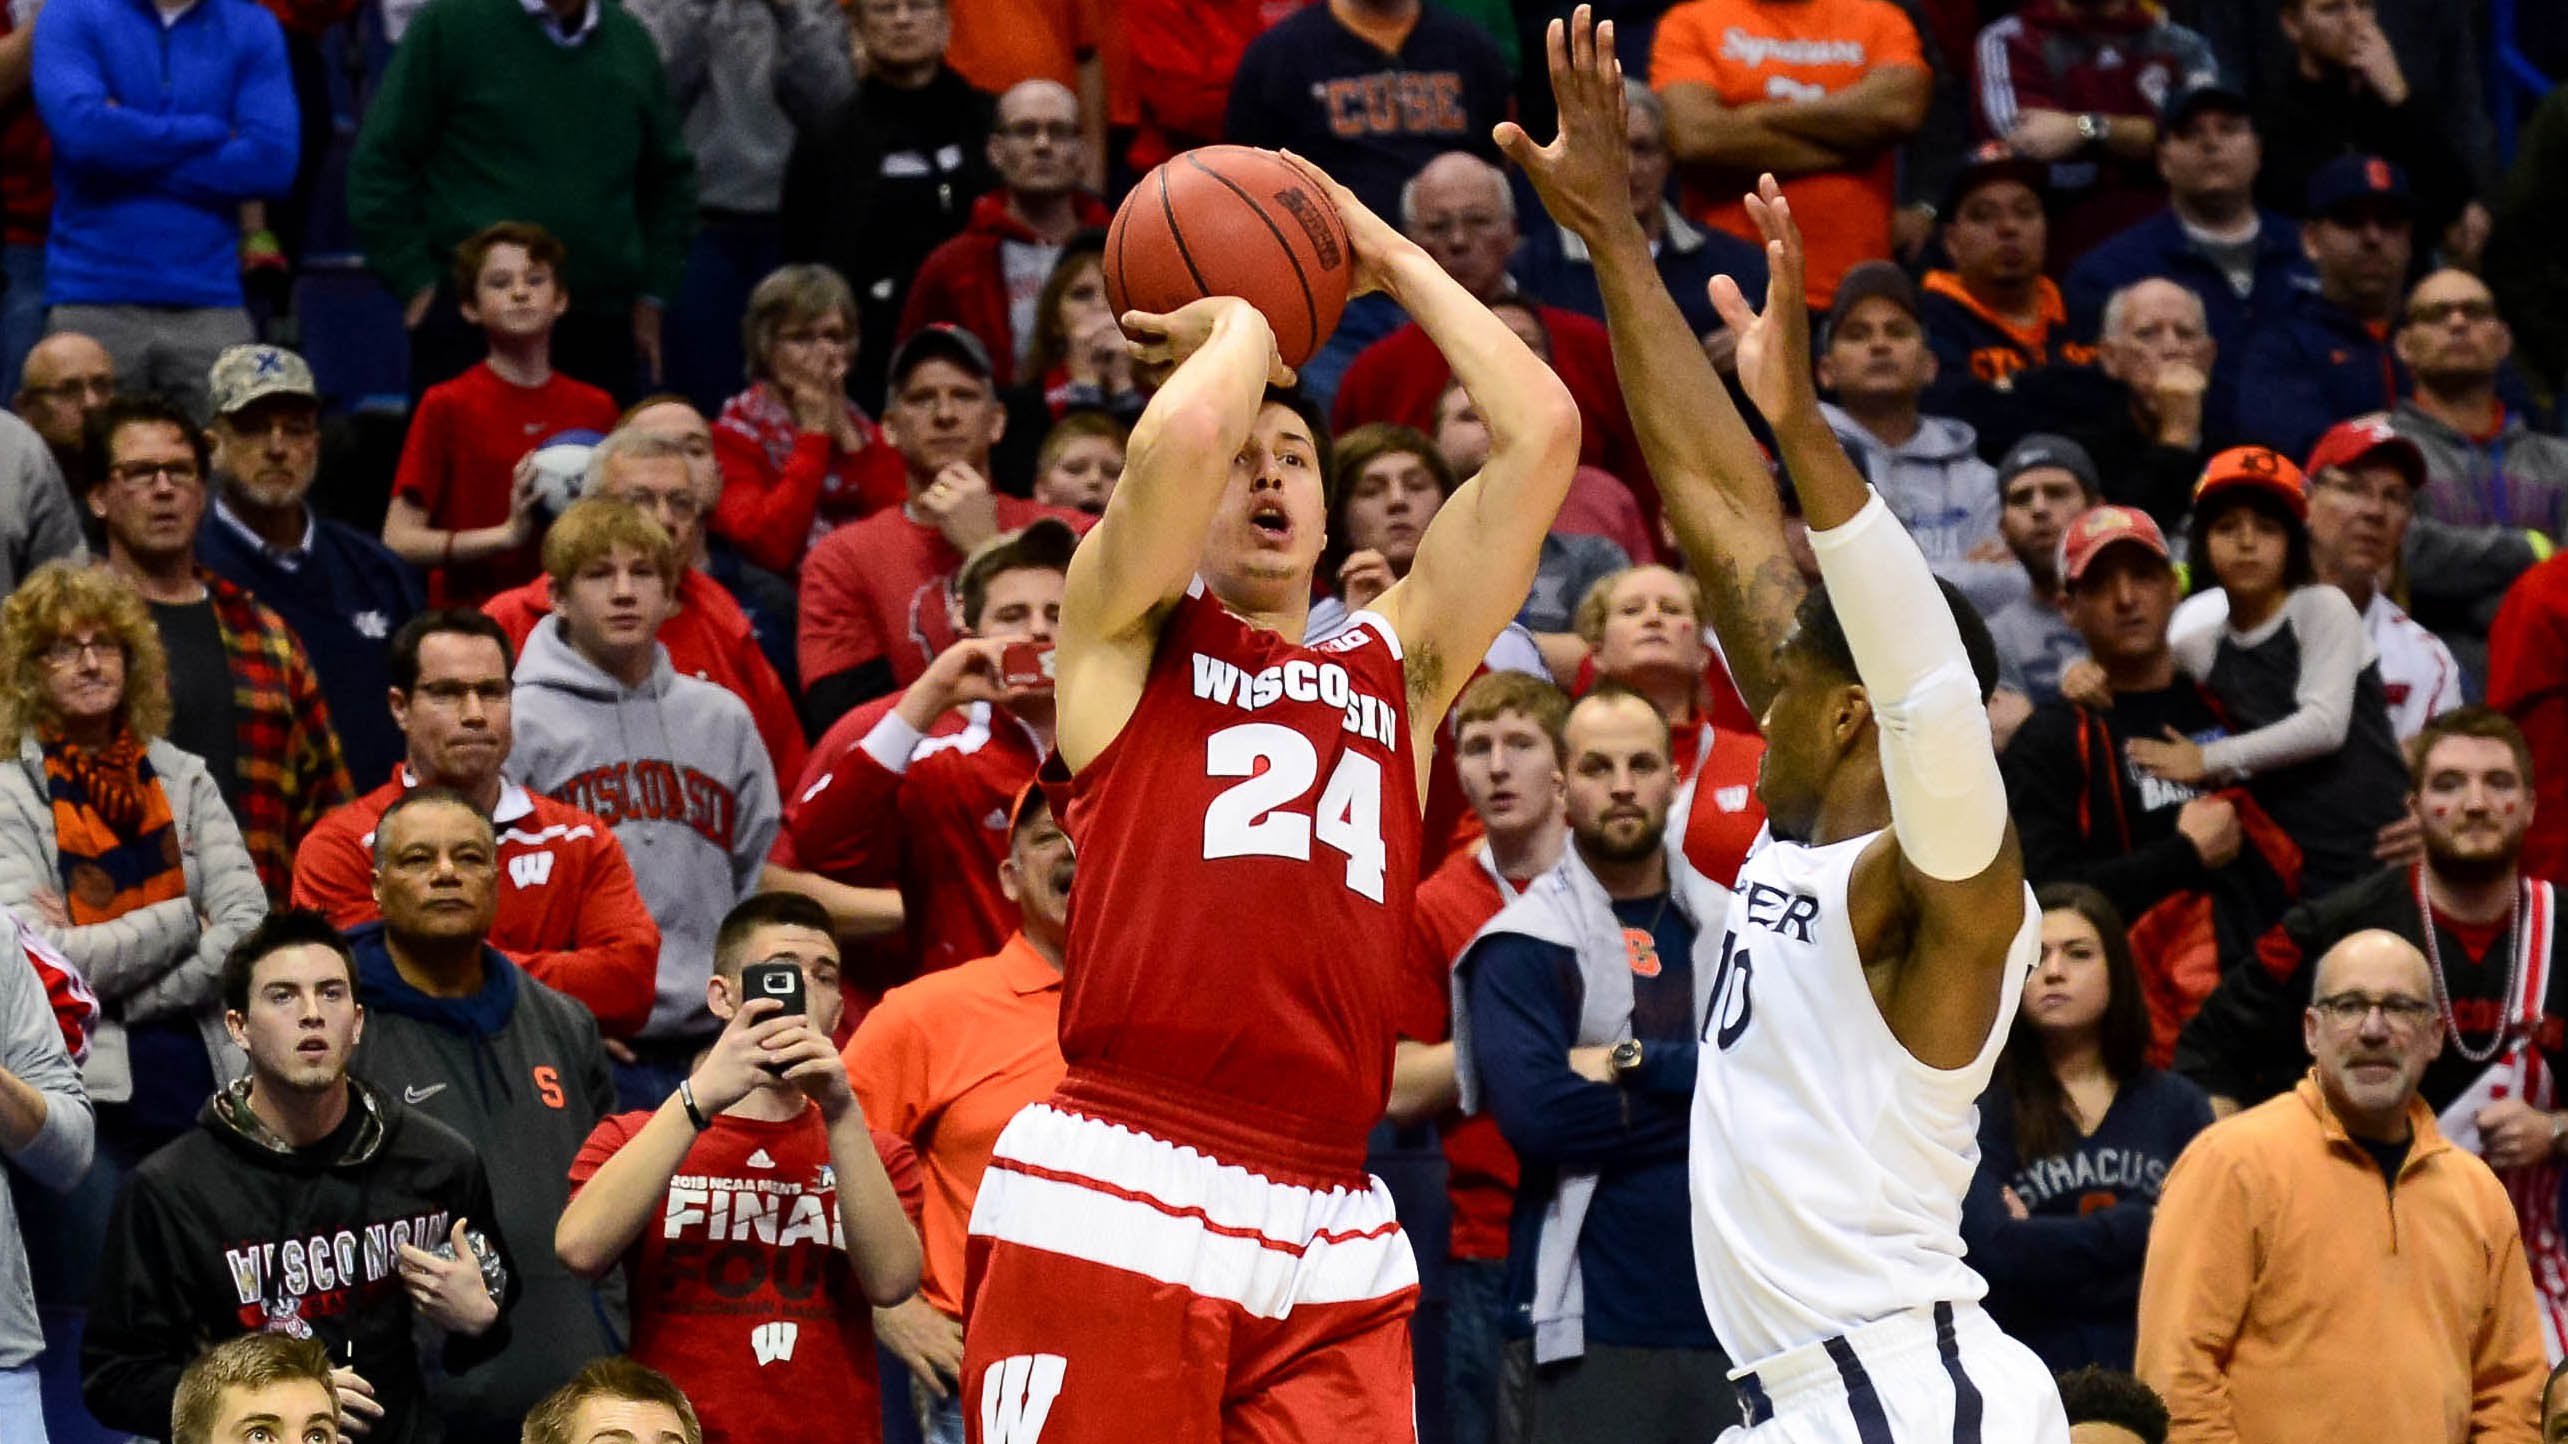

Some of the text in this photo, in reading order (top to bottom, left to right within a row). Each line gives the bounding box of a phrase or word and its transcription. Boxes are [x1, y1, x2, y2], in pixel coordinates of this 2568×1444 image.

[1192, 652, 1397, 753] WISCONSIN
[1203, 722, 1386, 905] 24
[508, 850, 555, 890] W
[532, 1065, 565, 1109] S
[709, 1177, 756, 1192] NCAA
[2014, 1147, 2167, 1210] SYRACUS
[659, 1243, 850, 1301] FOU
[751, 1321, 798, 1367] W
[981, 1352, 1068, 1444] W
